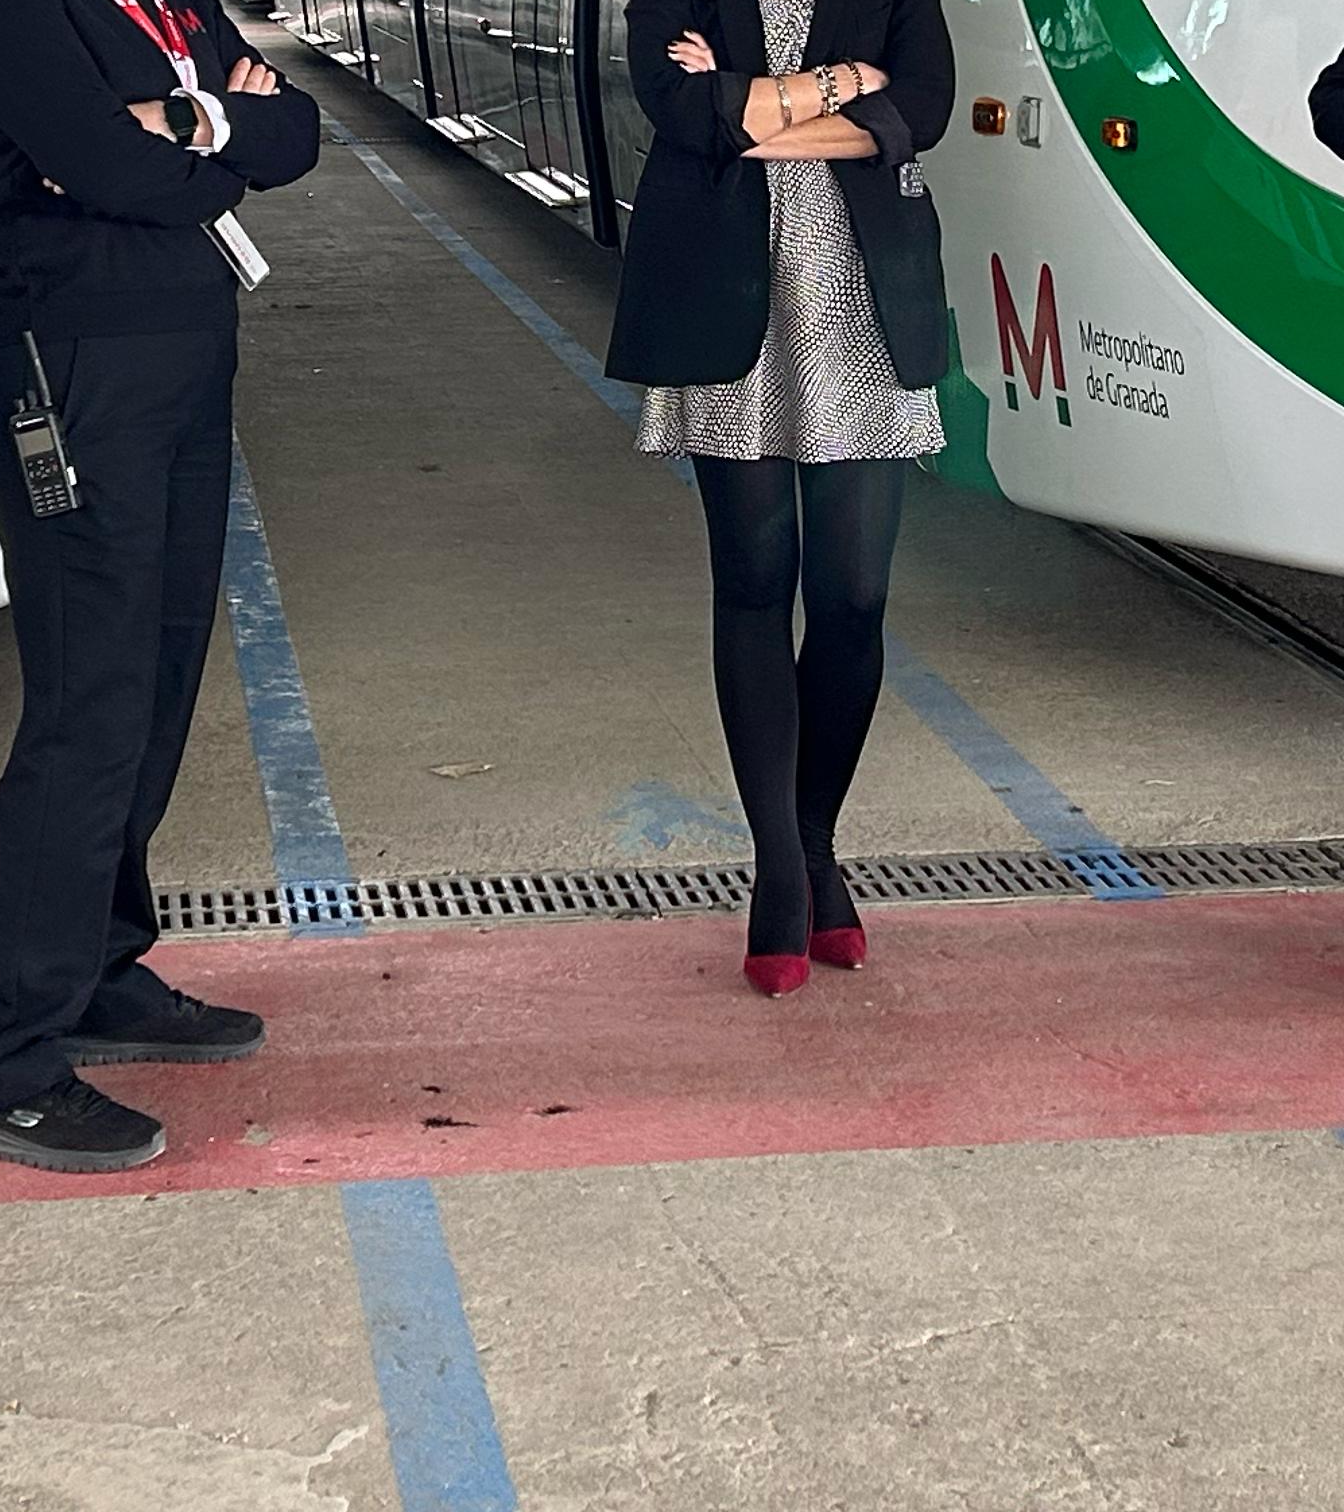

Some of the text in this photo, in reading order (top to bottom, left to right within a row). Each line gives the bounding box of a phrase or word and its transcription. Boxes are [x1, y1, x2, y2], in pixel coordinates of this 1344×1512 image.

[990, 251, 1073, 428] M
[1078, 319, 1186, 376] Metropolitano
[1086, 364, 1170, 420] de Granada
